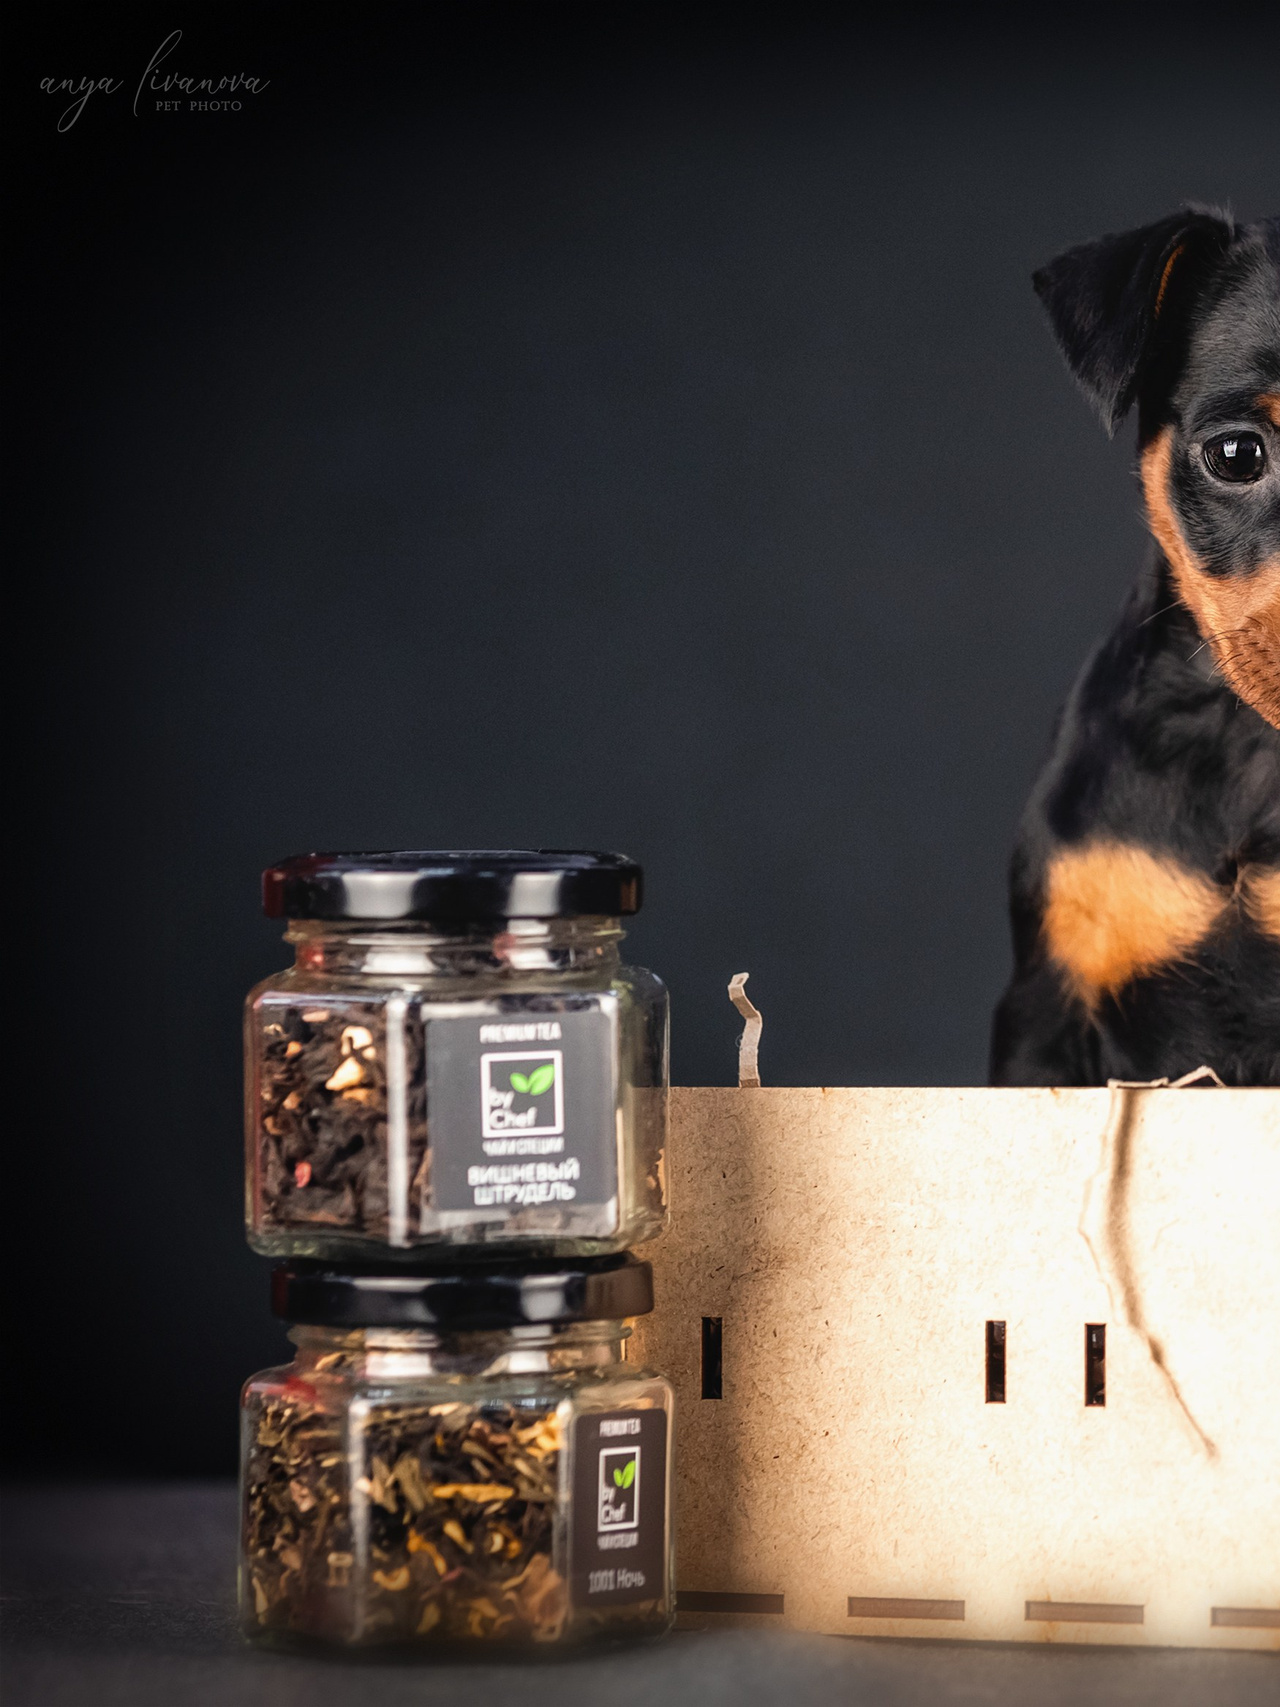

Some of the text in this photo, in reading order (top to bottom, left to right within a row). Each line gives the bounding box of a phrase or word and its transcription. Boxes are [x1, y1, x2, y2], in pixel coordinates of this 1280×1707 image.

[480, 1022, 562, 1044] PREMIUM TEA
[490, 1106, 538, 1129] Chef
[468, 1157, 580, 1186] ВИШНЕВЫЙ
[474, 1181, 577, 1206] ШТРУДЕЛЬ
[601, 1501, 627, 1523] Chef
